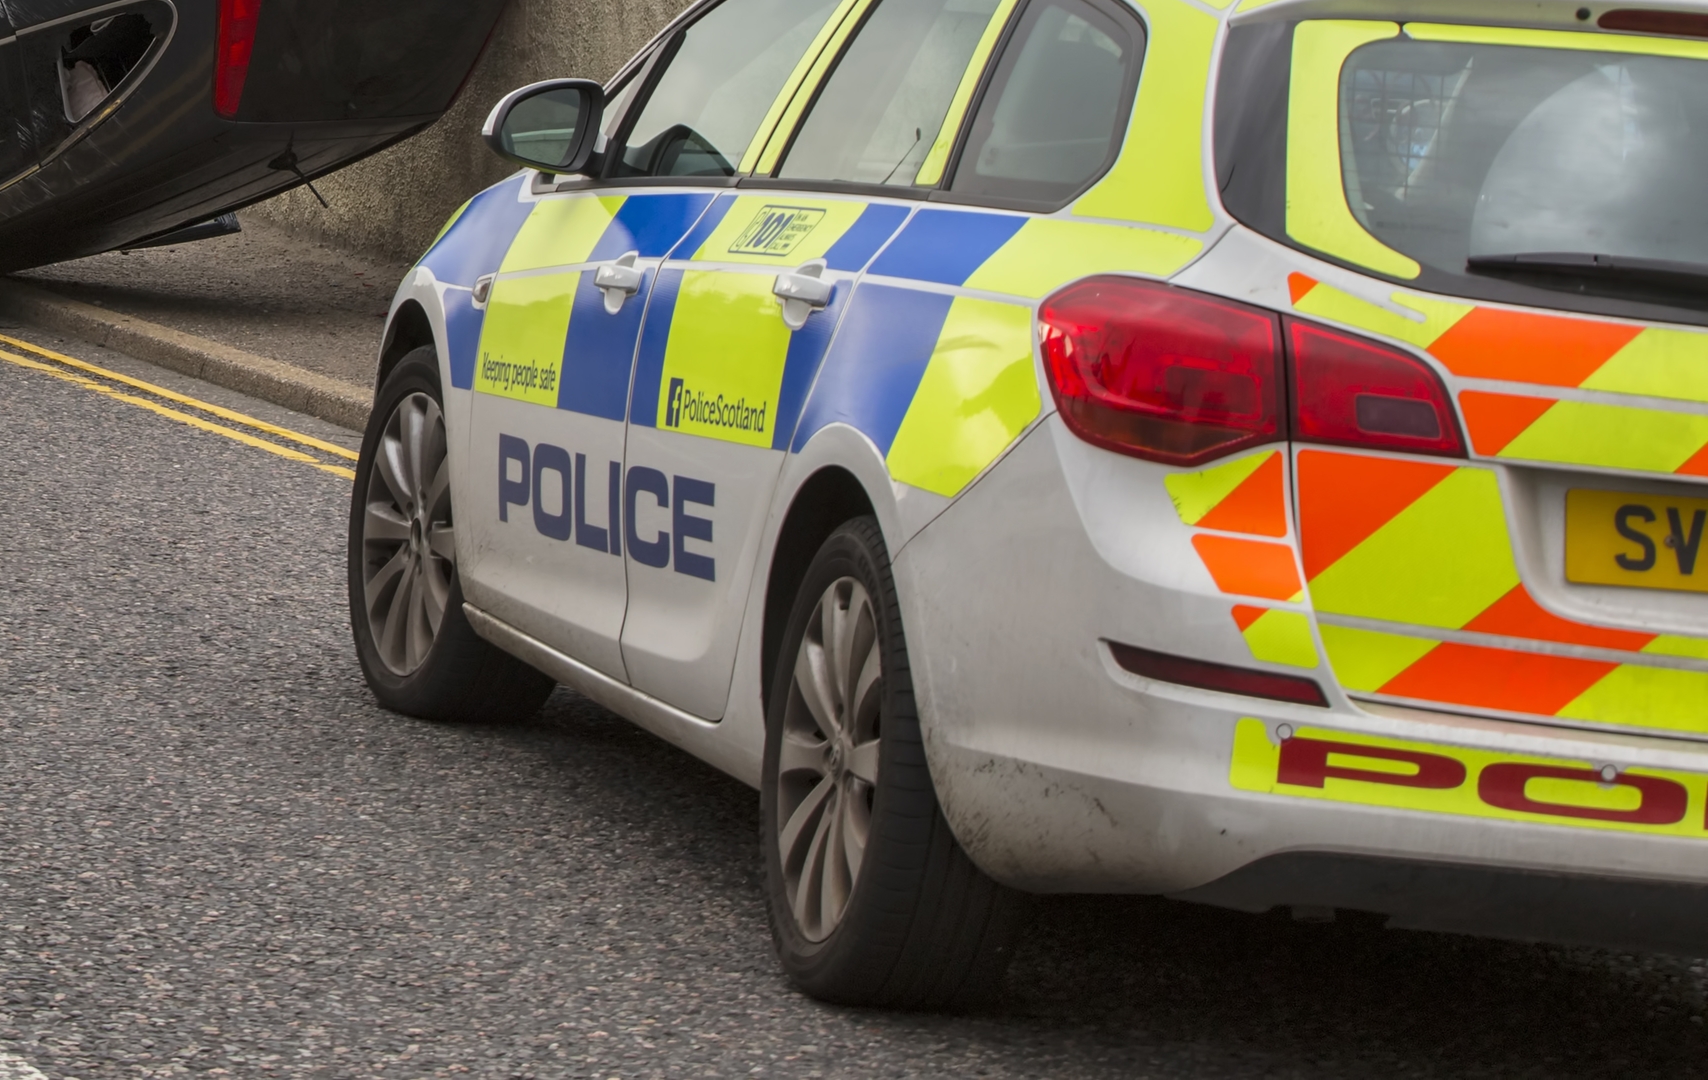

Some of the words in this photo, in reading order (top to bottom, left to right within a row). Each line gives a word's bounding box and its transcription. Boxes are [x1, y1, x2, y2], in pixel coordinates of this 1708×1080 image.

[744, 212, 795, 248] 101
[481, 351, 512, 391] Keeping
[510, 359, 538, 394] people
[539, 362, 556, 391] safe
[683, 389, 767, 433] PoliceScotland
[498, 432, 716, 582] POLICE
[1276, 735, 1708, 831] PO
